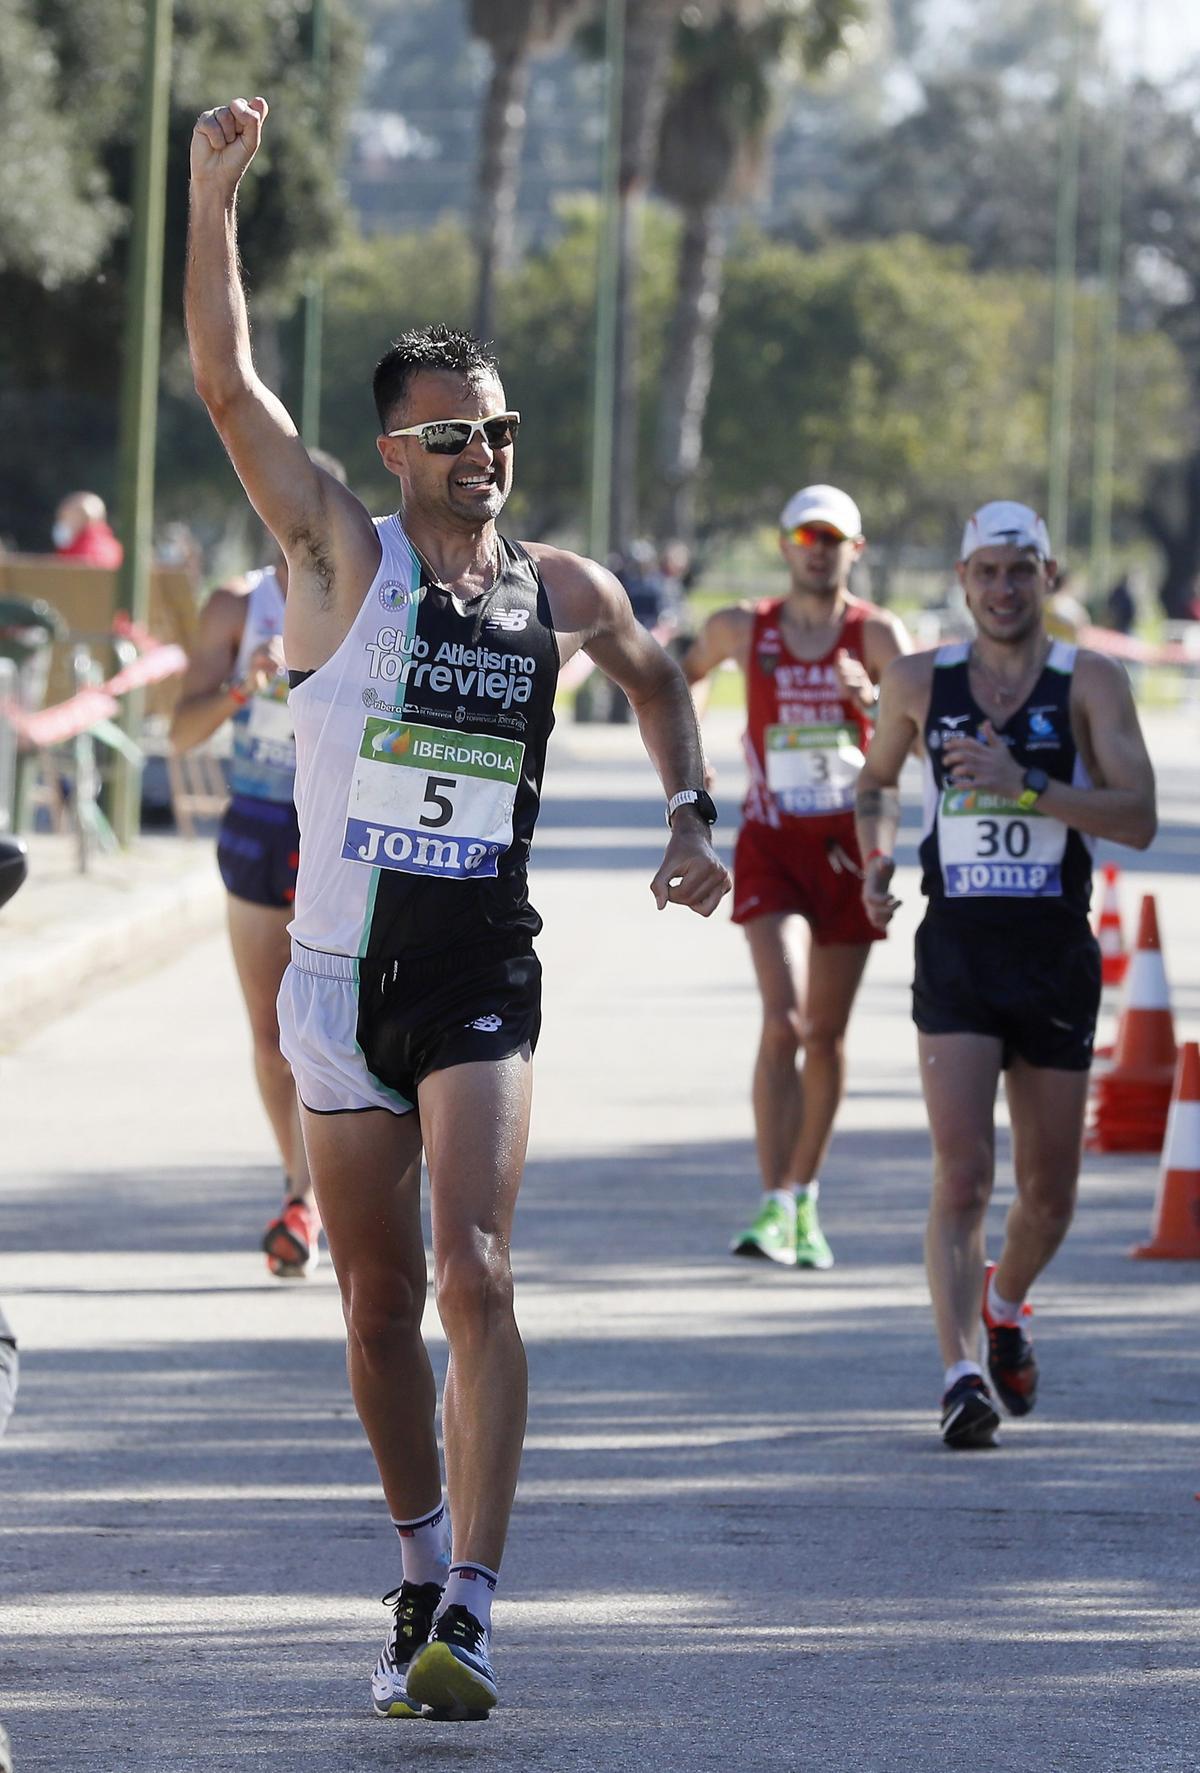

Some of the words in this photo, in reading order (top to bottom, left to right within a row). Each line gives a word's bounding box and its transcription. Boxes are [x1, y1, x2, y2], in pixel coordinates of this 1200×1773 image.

[376, 626, 430, 659] Club
[434, 641, 537, 675] Atletismo
[365, 643, 533, 710] Torrevieja
[373, 700, 402, 714] ribera
[412, 740, 516, 773] IBERDROLA
[811, 751, 829, 784] 3
[418, 775, 458, 828] 5
[976, 820, 1031, 858] 30
